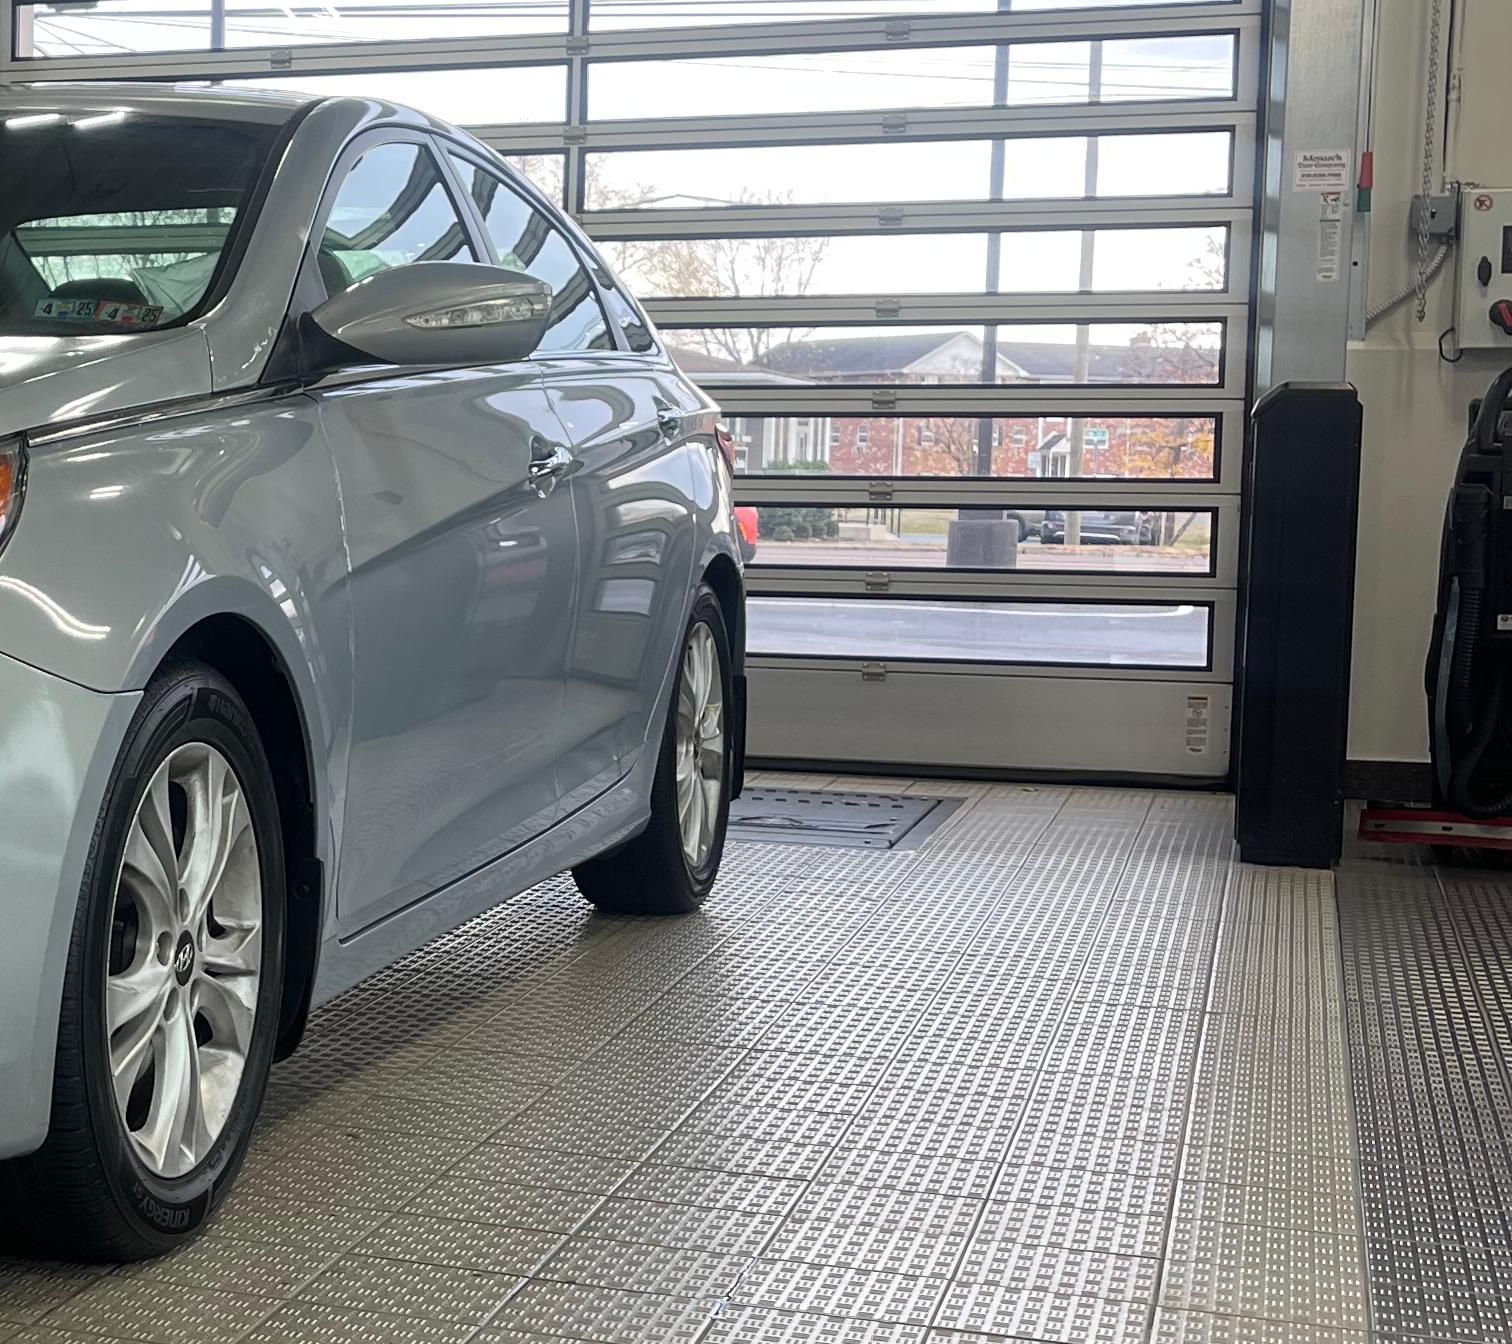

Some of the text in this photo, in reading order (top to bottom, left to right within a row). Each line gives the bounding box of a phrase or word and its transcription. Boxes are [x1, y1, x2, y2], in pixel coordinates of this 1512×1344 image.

[42, 303, 53, 315] 4
[76, 301, 93, 316] 25
[108, 308, 119, 320] 4
[142, 308, 158, 323] 25
[138, 1196, 190, 1228] KINERGY
